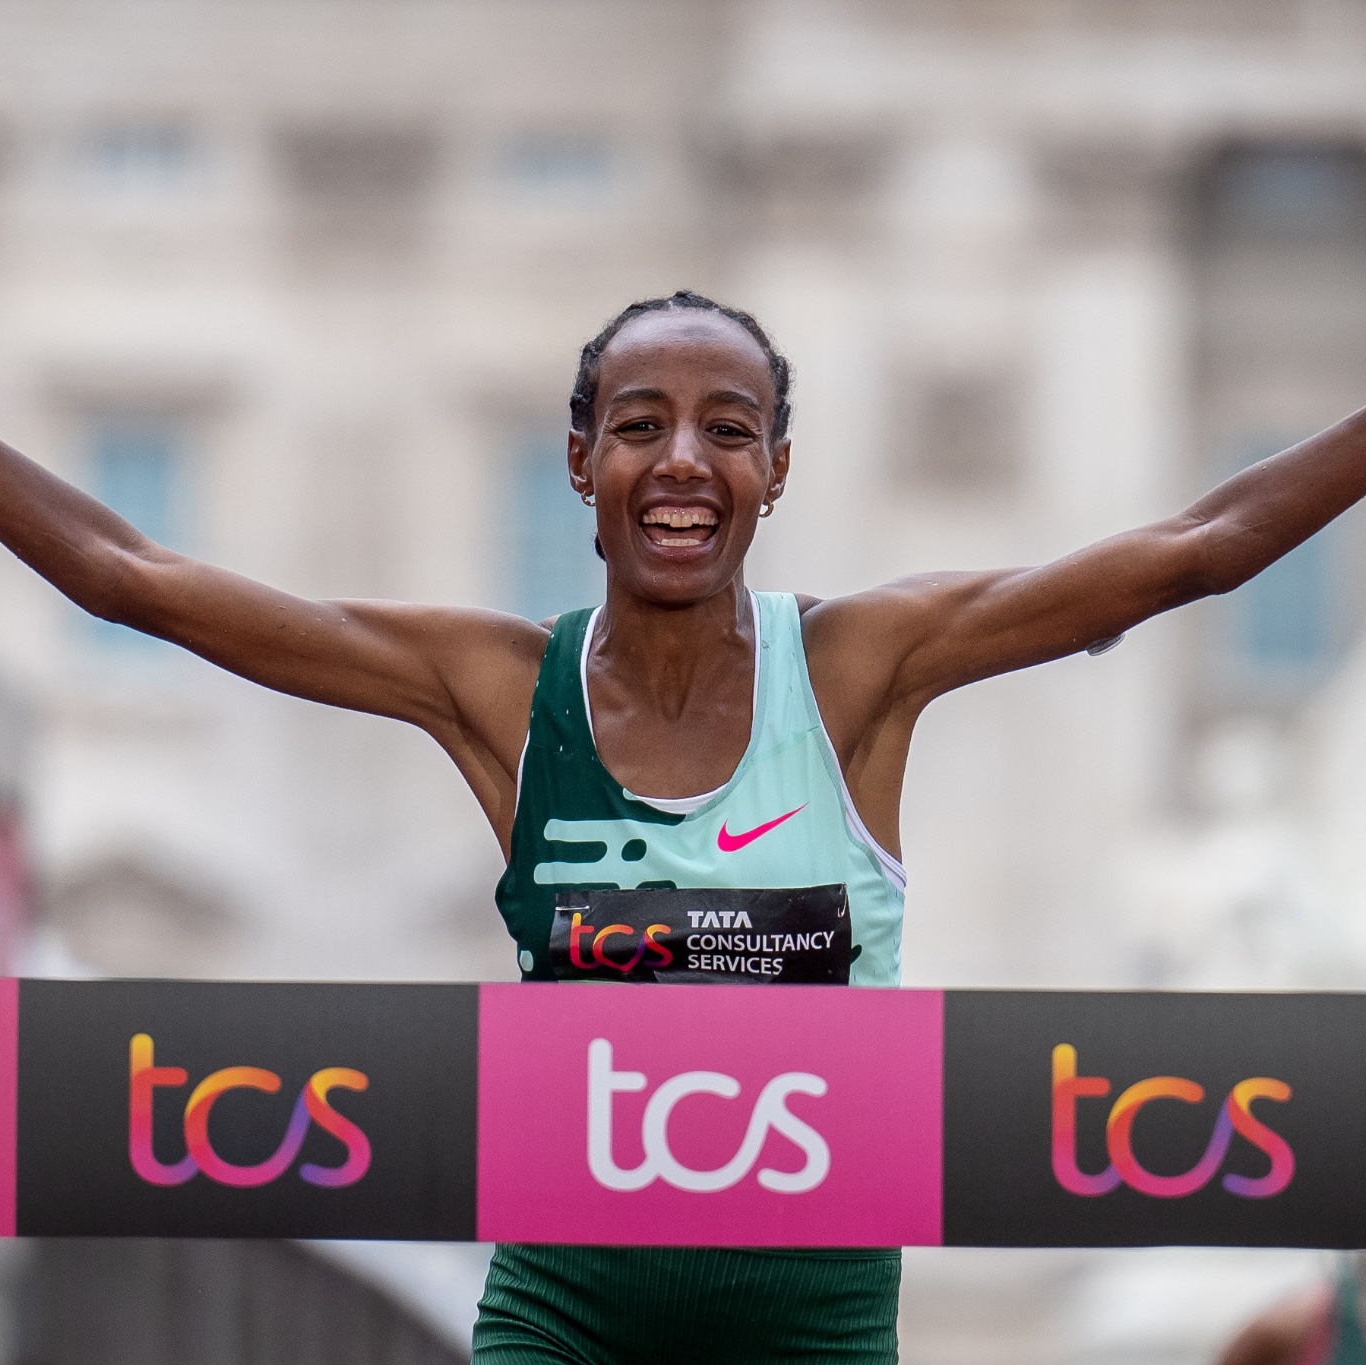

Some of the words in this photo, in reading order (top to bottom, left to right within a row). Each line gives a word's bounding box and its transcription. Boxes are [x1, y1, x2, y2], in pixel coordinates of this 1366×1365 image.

[569, 912, 674, 973] tcs
[686, 910, 753, 928] TATA
[686, 930, 835, 953] CONSULTANCY
[687, 953, 784, 975] SERVICES
[127, 1032, 373, 1189] tcs
[587, 1037, 831, 1193] tcs
[1050, 1042, 1296, 1199] tcs
